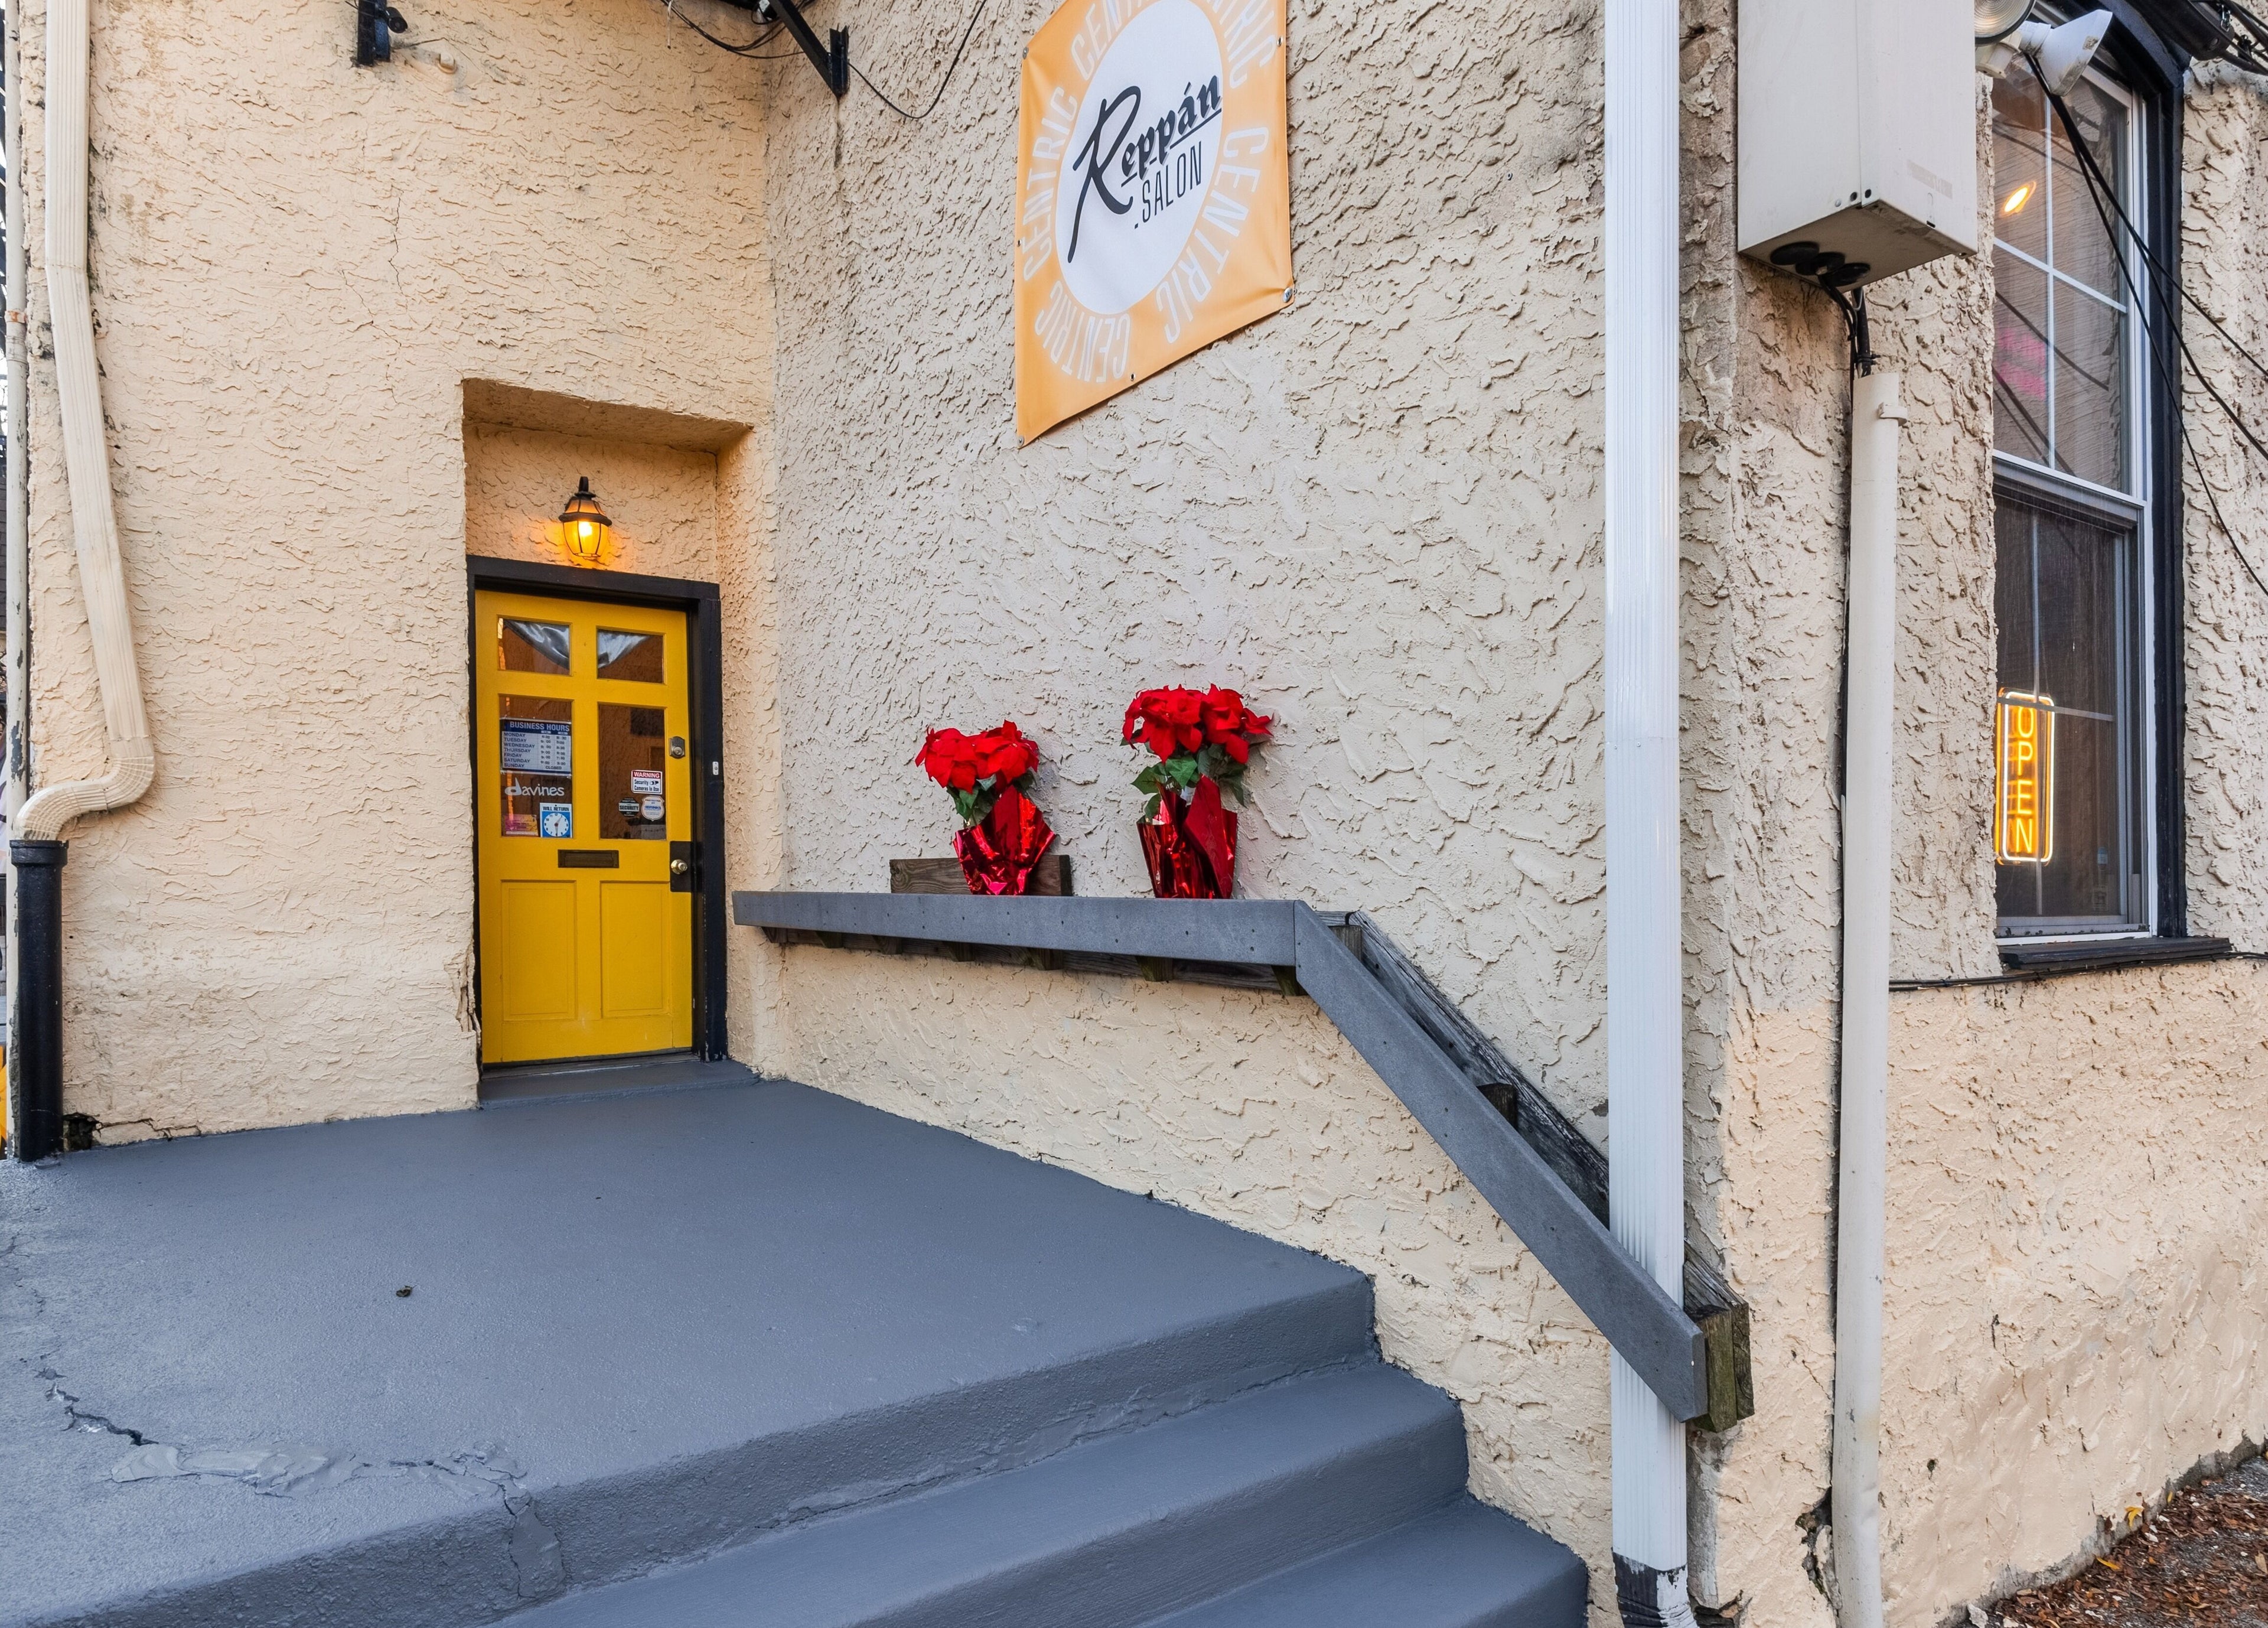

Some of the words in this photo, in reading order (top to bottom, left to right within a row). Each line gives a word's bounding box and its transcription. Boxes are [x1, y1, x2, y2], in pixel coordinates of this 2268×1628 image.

[1022, 86, 1078, 281] CENTRIC
[1067, 74, 1222, 263] Reppán
[1155, 126, 1270, 344] CENTRIC
[1034, 280, 1131, 383] CENTRIC
[504, 777, 565, 796] davines
[510, 721, 545, 730] BUSINESS
[546, 724, 569, 732] HOURS
[2015, 706, 2034, 854] OPEN
